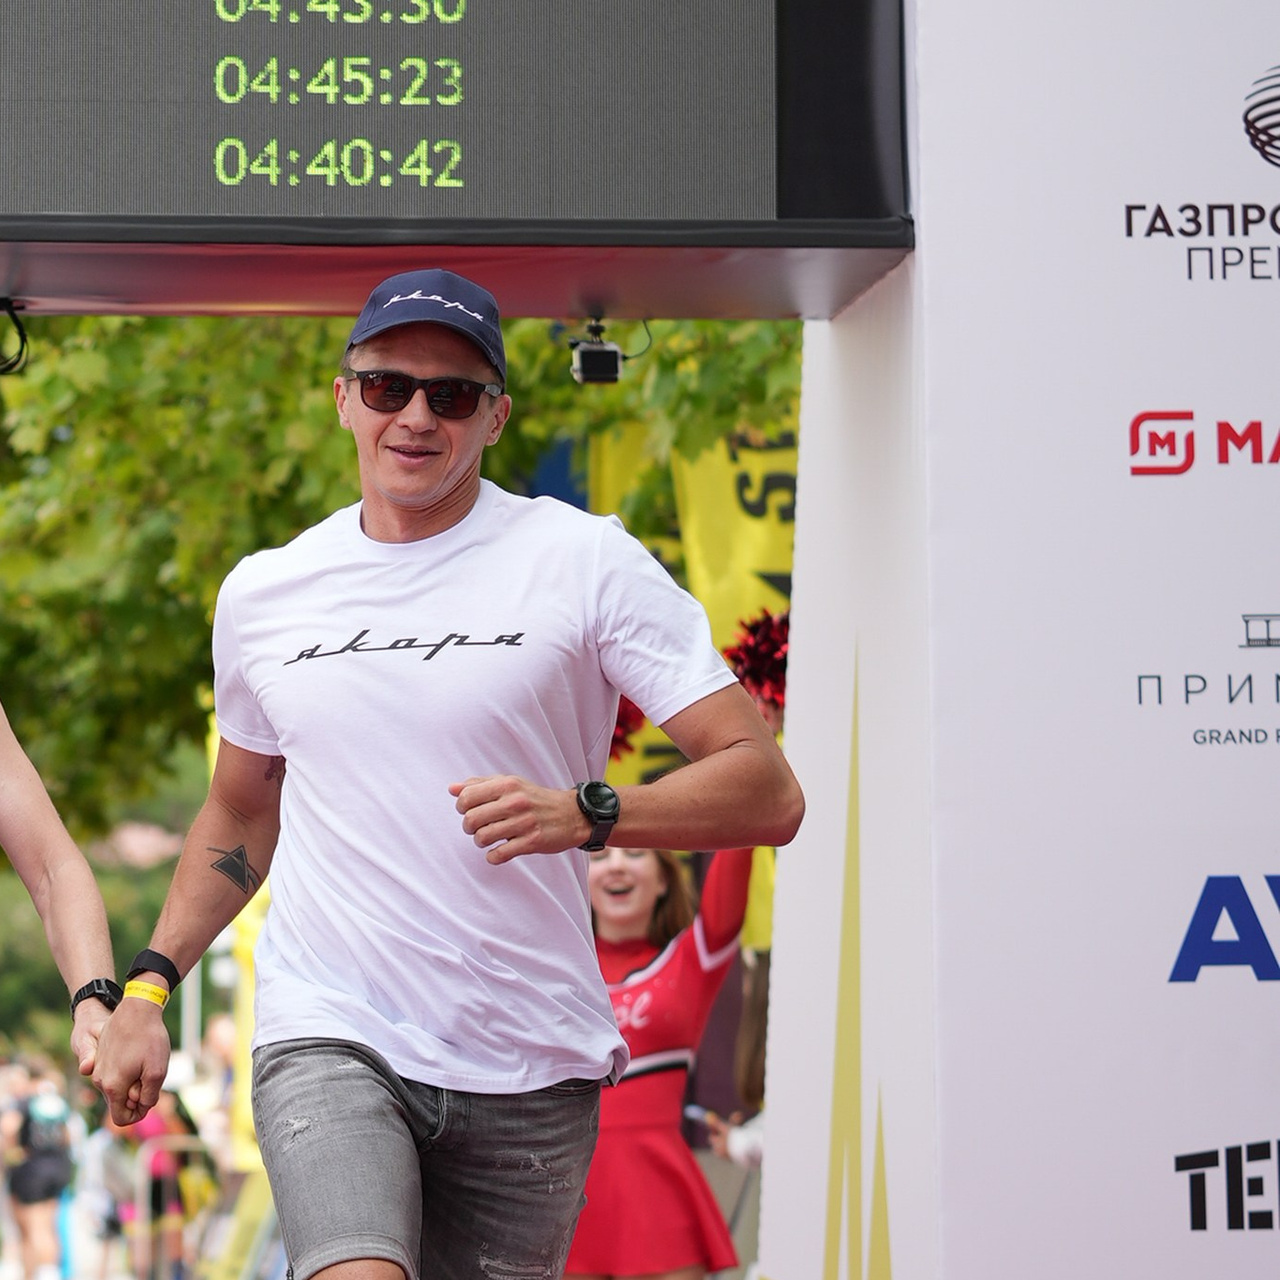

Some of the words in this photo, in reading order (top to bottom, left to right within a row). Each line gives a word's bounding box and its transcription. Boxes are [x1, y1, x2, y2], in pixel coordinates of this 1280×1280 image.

[213, 55, 465, 105] 04:45:23
[213, 137, 465, 188] 04:40:42
[1187, 246, 1280, 280] ПРЕ
[1137, 673, 1280, 705] ПРИ
[1193, 728, 1269, 745] GRAND
[1168, 874, 1280, 983] A
[1175, 1138, 1280, 1232] TE
